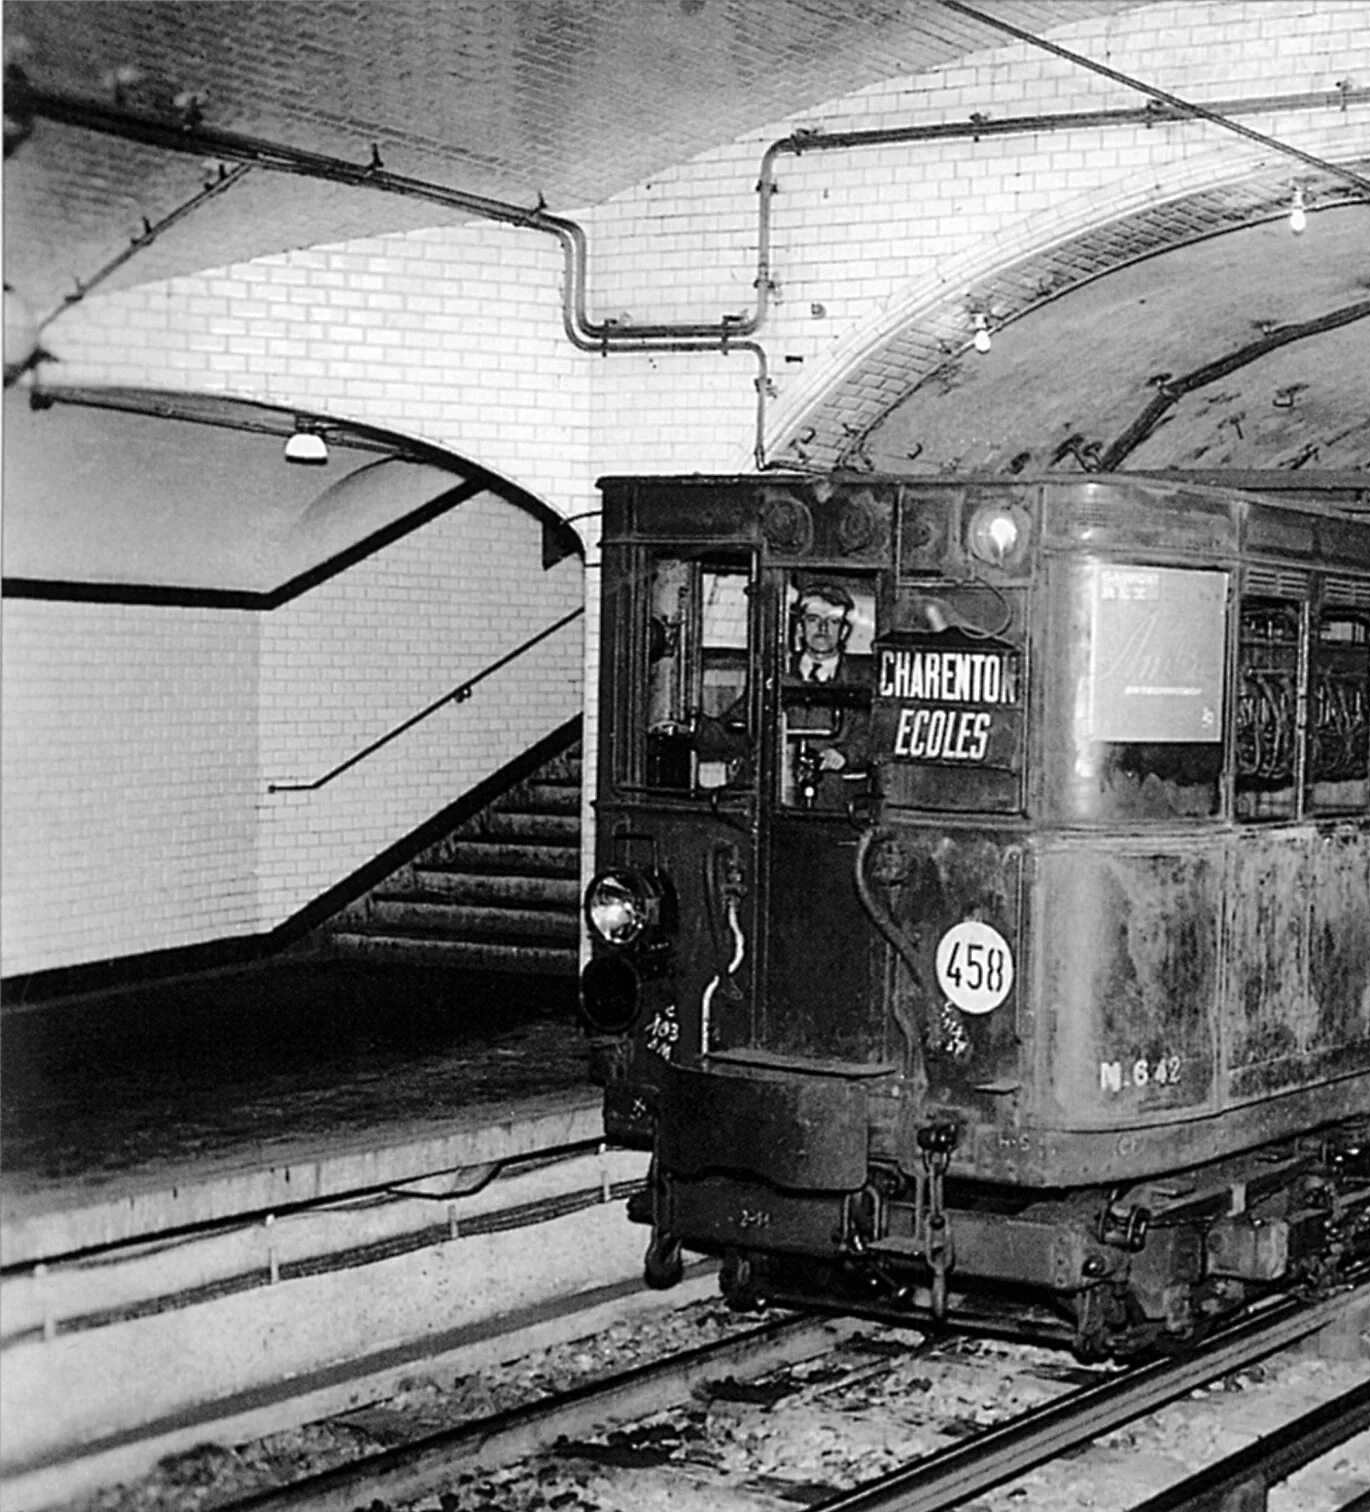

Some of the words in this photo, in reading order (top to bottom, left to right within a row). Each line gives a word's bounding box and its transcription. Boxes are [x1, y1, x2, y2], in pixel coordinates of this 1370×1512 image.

[880, 651, 1017, 703] CHARENTON
[894, 709, 991, 759] ECOLES
[947, 941, 1004, 993] 458
